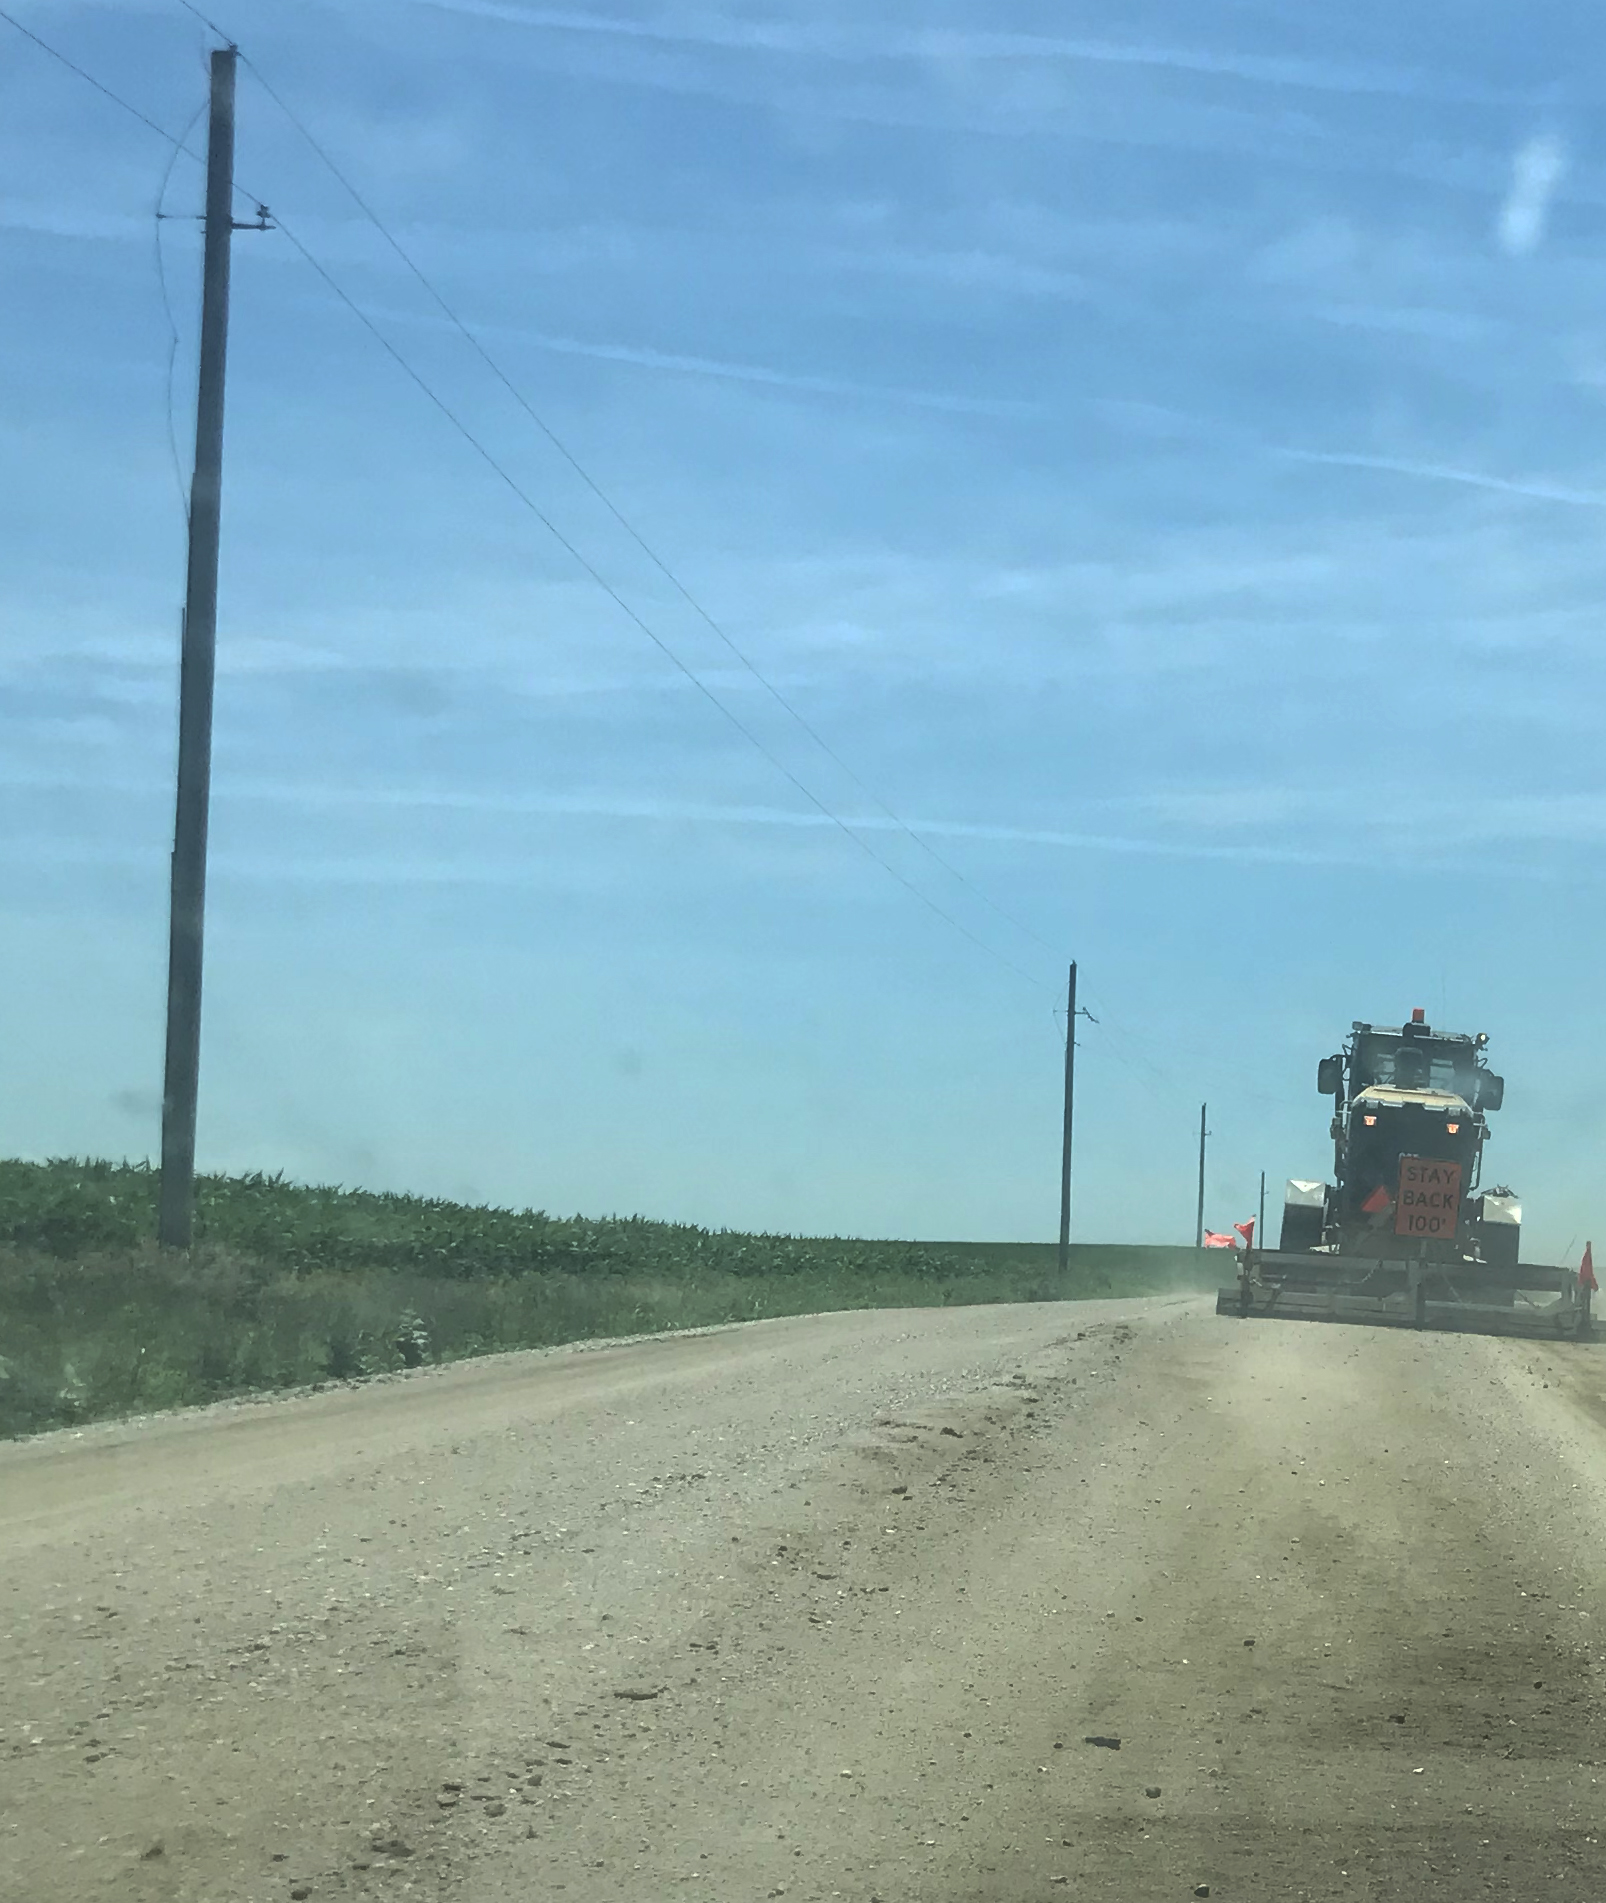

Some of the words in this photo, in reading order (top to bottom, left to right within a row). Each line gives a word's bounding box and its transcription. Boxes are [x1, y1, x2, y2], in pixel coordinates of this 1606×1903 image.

[1407, 1166, 1456, 1184] STAY
[1403, 1190, 1454, 1209] BACK
[1408, 1214, 1446, 1233] 100'
